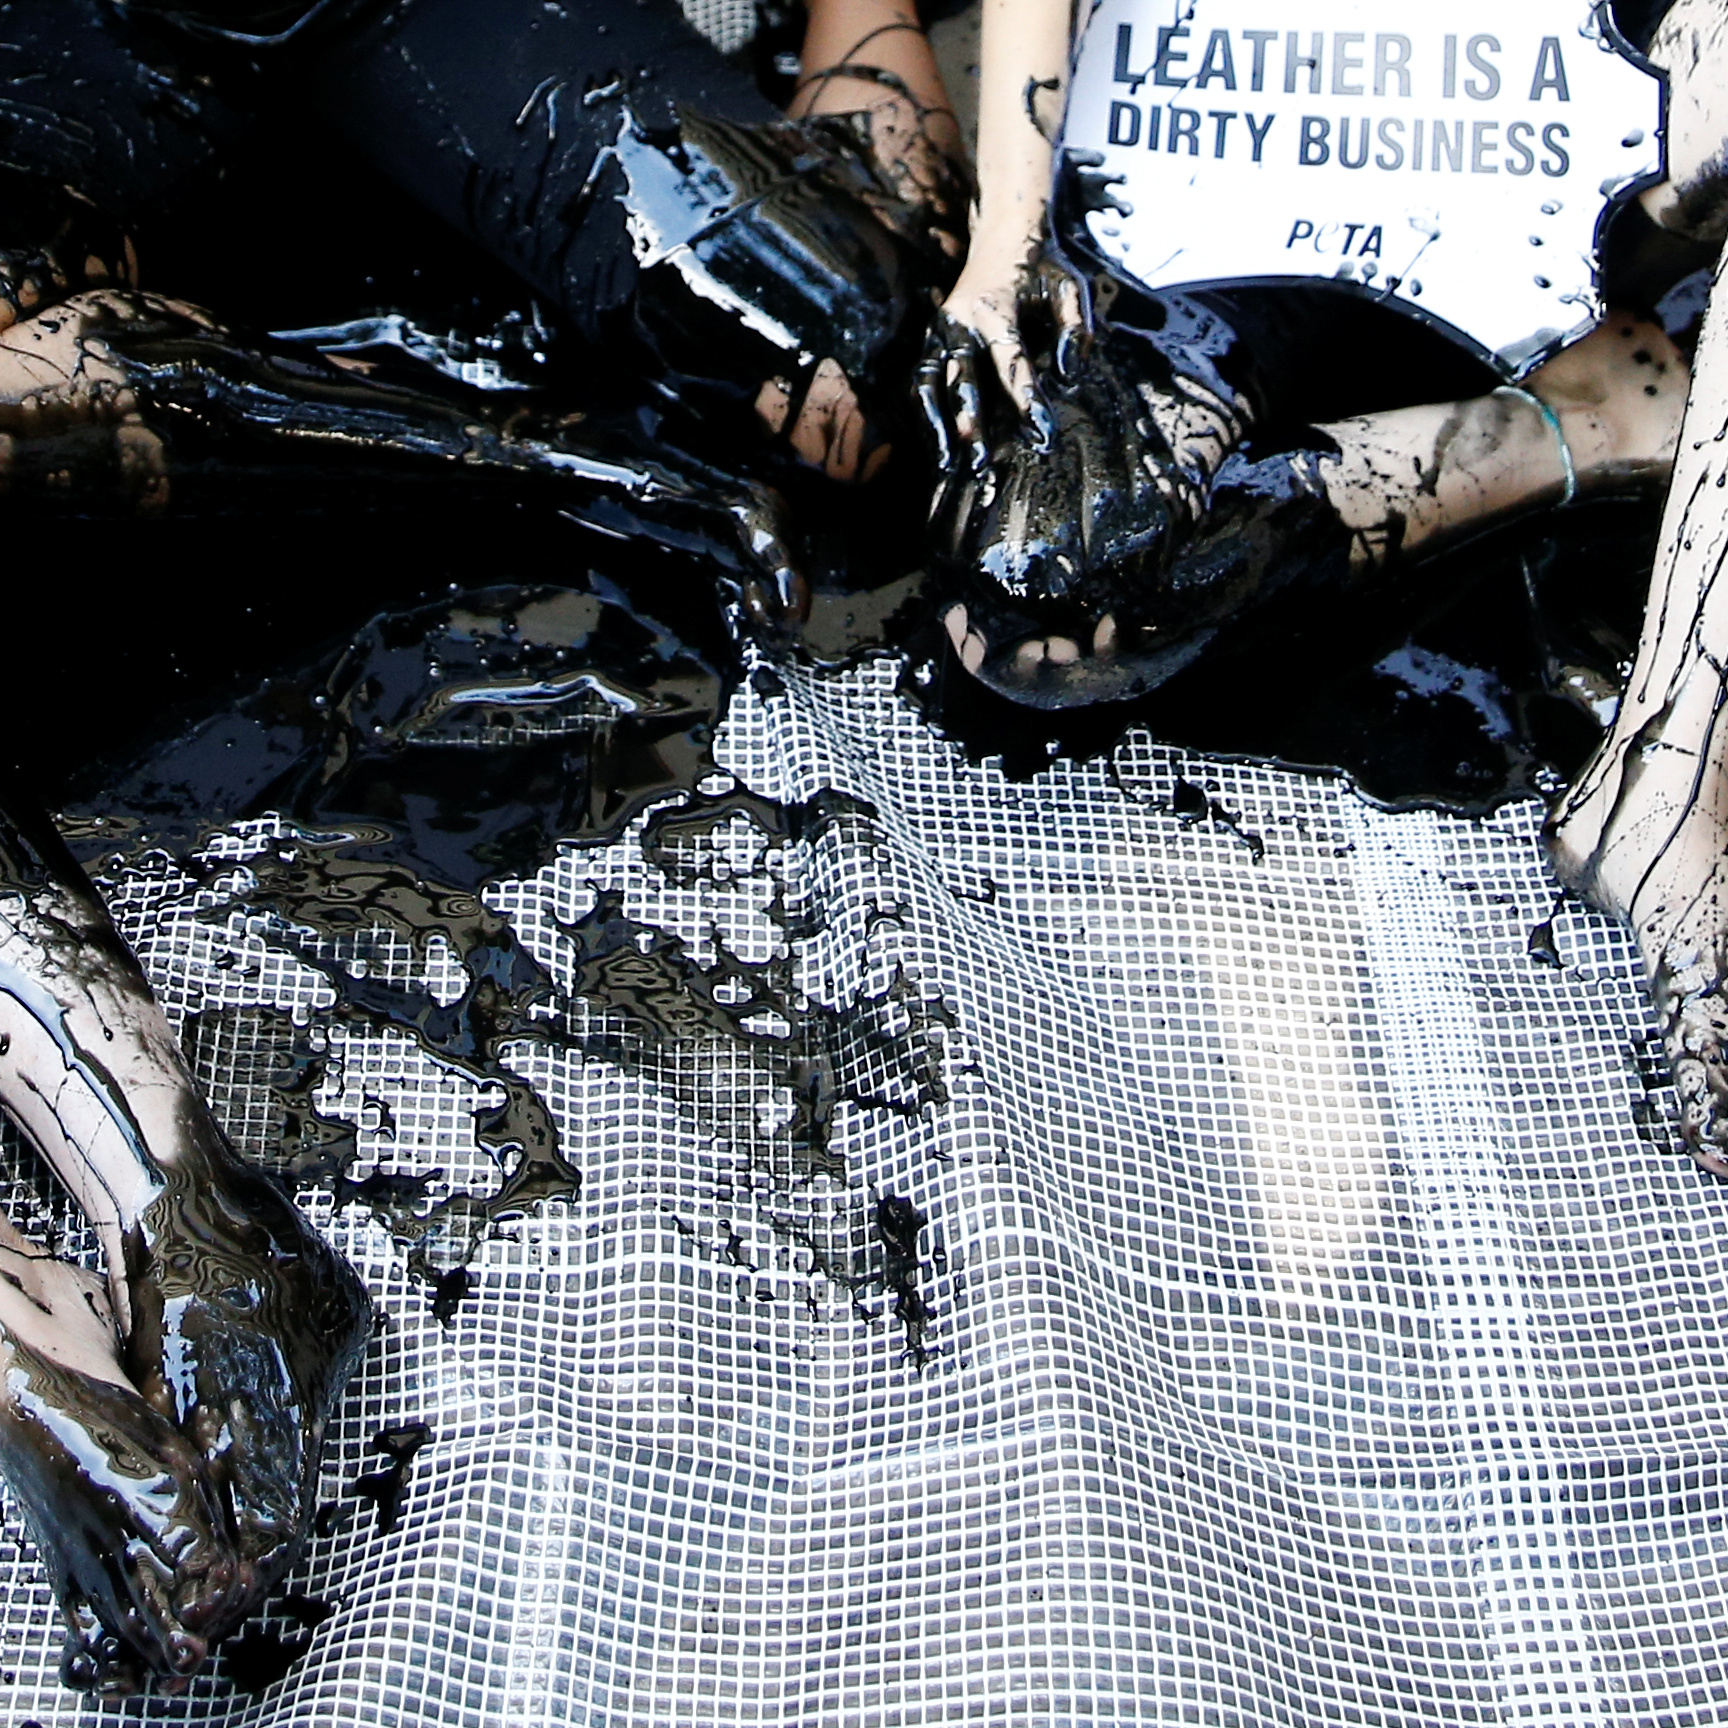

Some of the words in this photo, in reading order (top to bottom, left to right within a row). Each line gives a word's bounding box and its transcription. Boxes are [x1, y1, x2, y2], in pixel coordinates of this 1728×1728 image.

[1112, 23, 1413, 98] LEATHER
[1441, 33, 1502, 102] IS
[1529, 36, 1571, 102] A
[1107, 100, 1276, 163] DIRTY
[1298, 116, 1571, 179] BUSINESS
